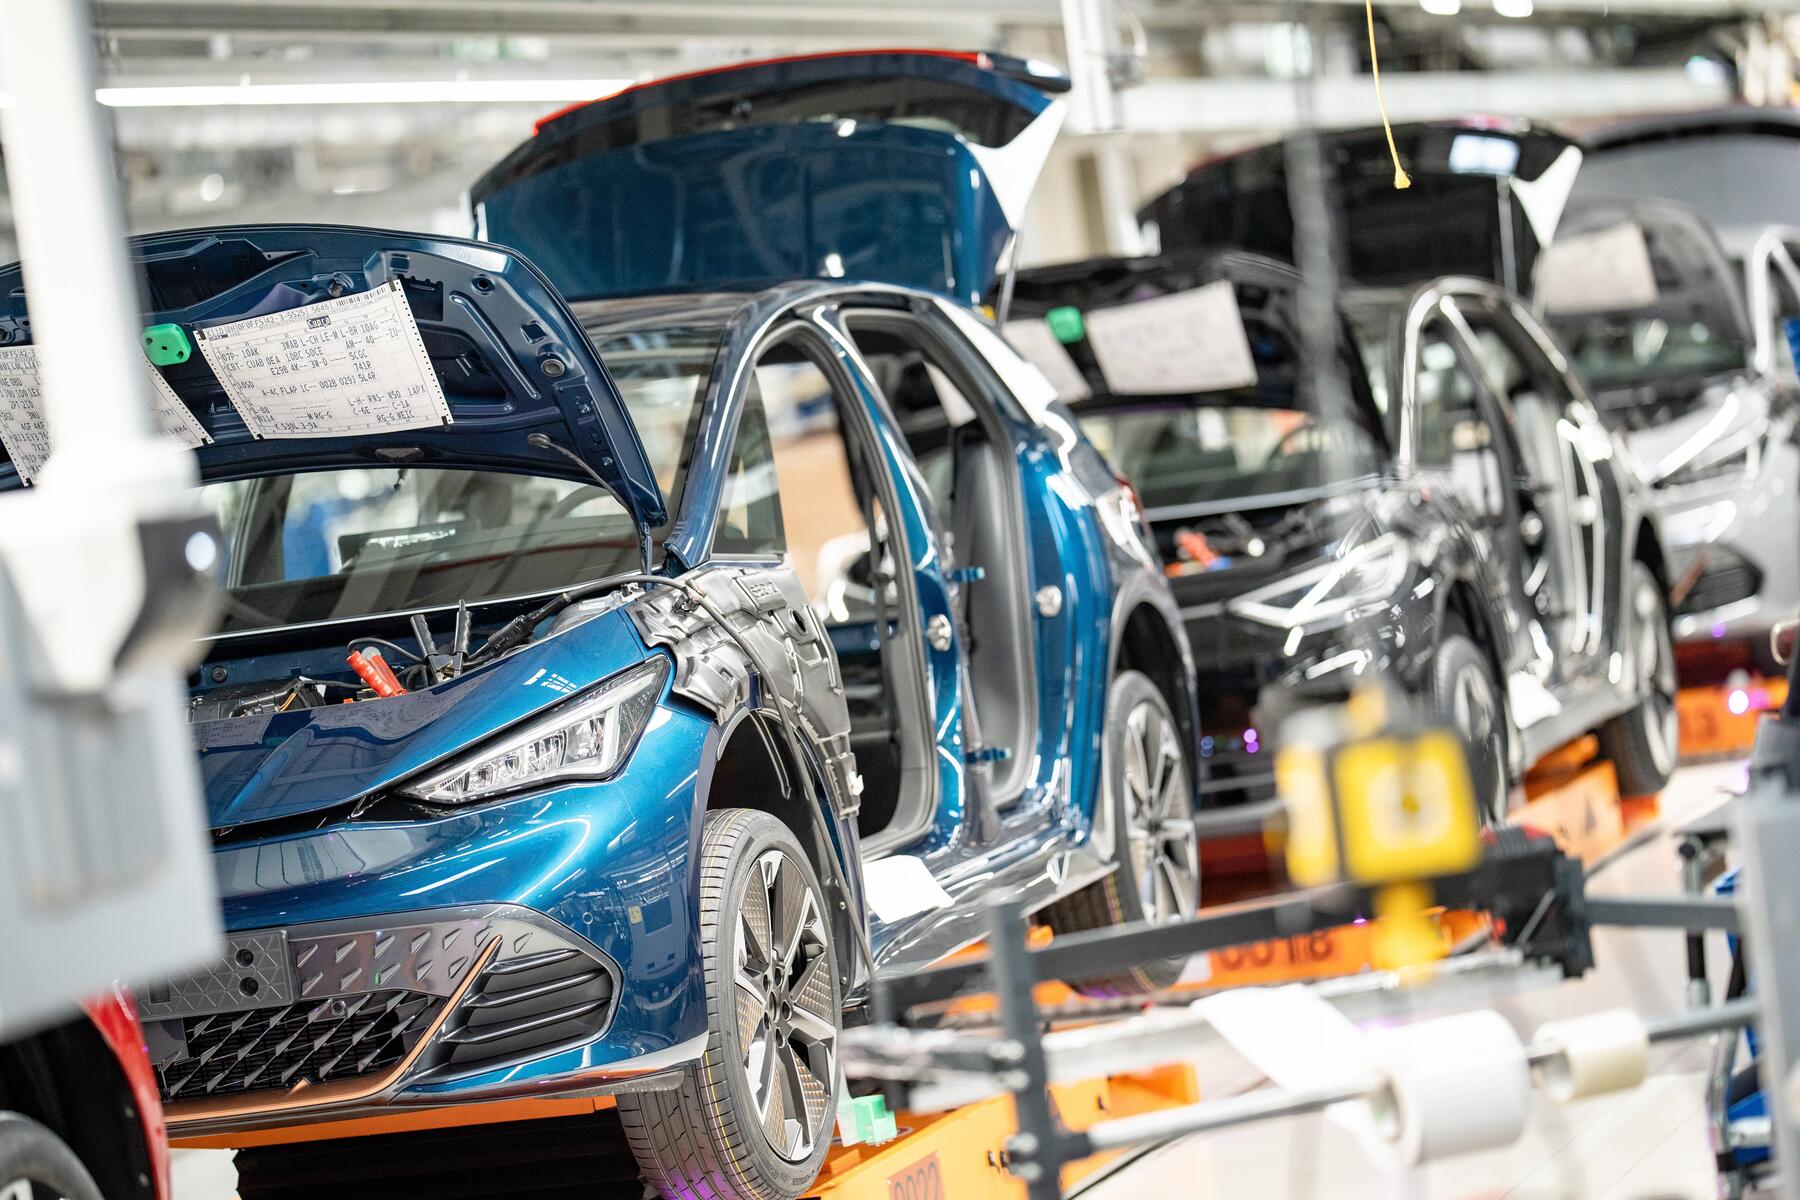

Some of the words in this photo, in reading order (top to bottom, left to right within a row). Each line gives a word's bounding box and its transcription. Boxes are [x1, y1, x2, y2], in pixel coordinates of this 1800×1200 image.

[306, 316, 331, 328] Cupra
[301, 335, 319, 345] L-CH
[280, 385, 298, 393] FLAP
